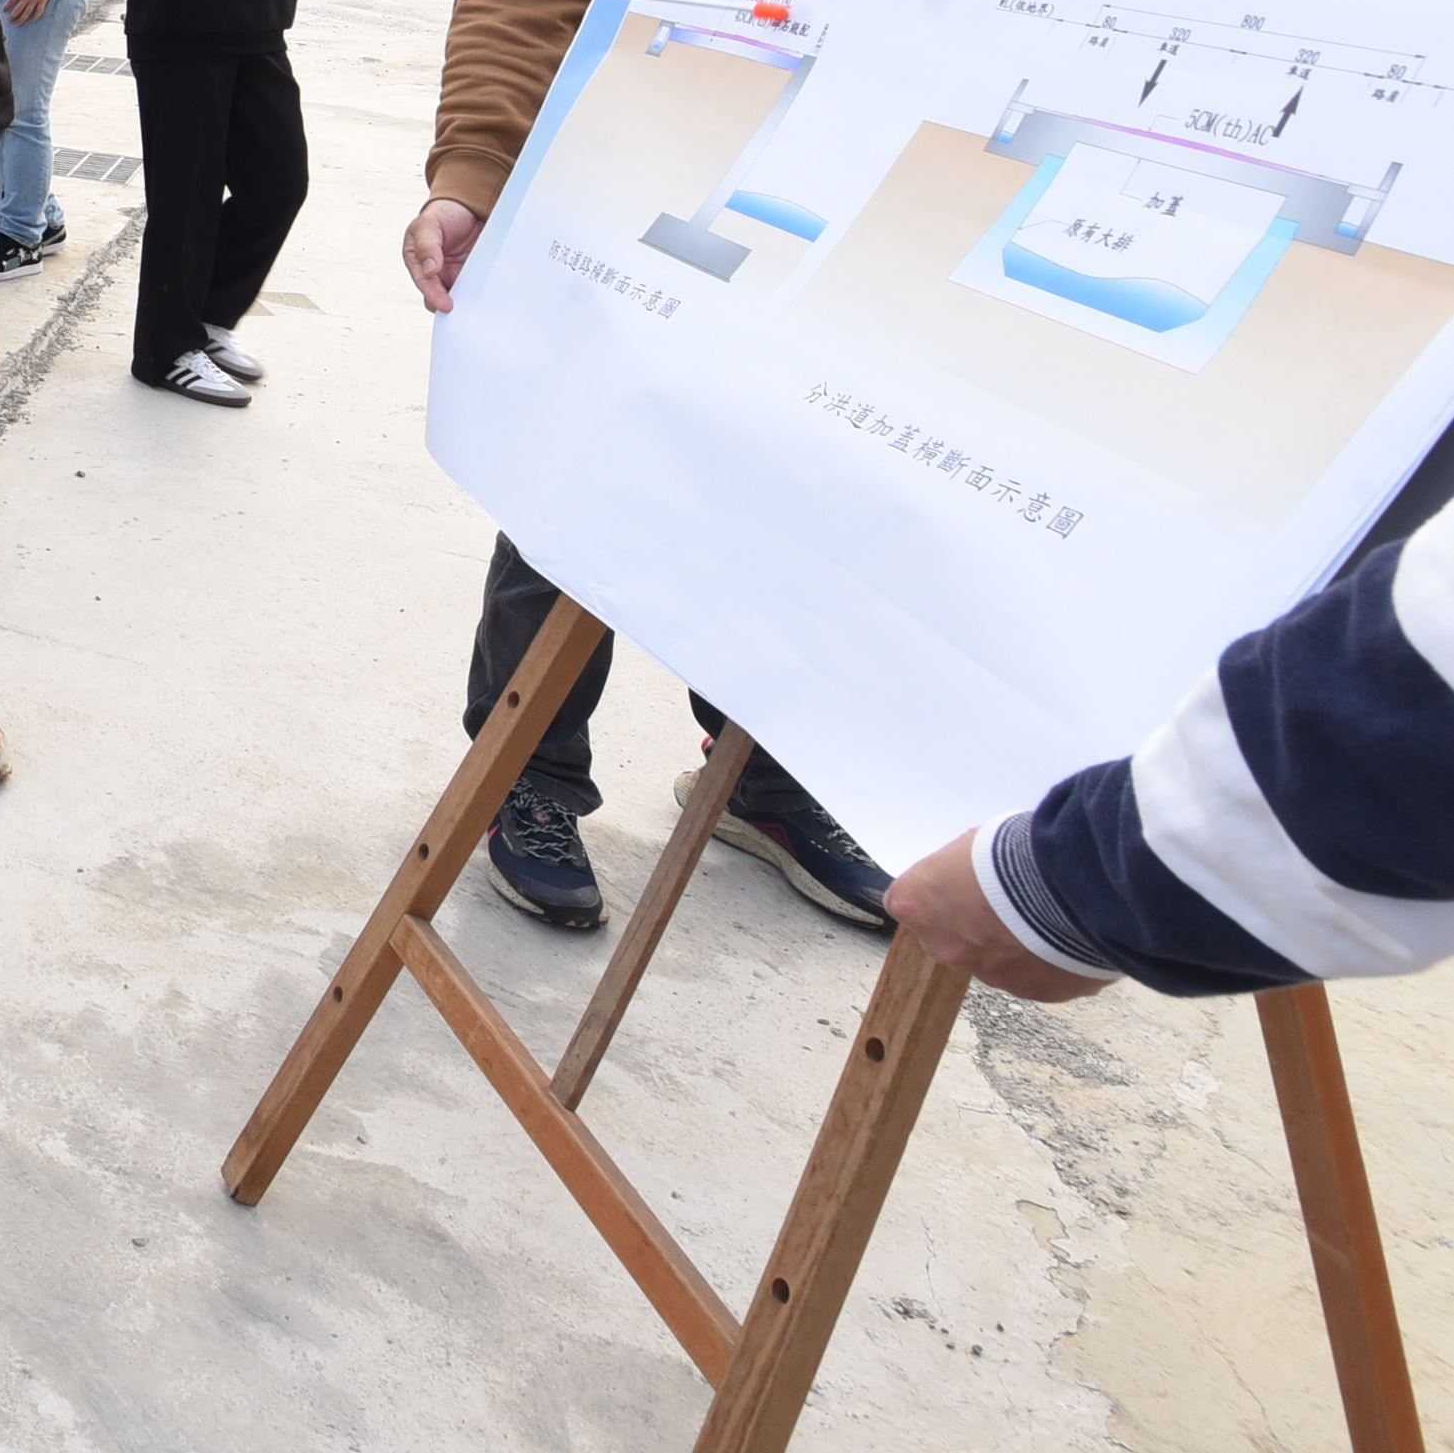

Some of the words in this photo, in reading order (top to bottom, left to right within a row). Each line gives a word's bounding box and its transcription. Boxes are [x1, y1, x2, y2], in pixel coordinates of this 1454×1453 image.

[1241, 15, 1265, 30] 800
[1169, 27, 1191, 42] 320
[1295, 48, 1320, 65] 320
[1387, 64, 1407, 80] 80
[1185, 109, 1274, 147] 5CM(th)AC
[1143, 192, 1183, 217] 加蓋
[1064, 218, 1134, 253] 原有大排
[802, 381, 1084, 540] 分洪道加蓋橫斷面示意圖
